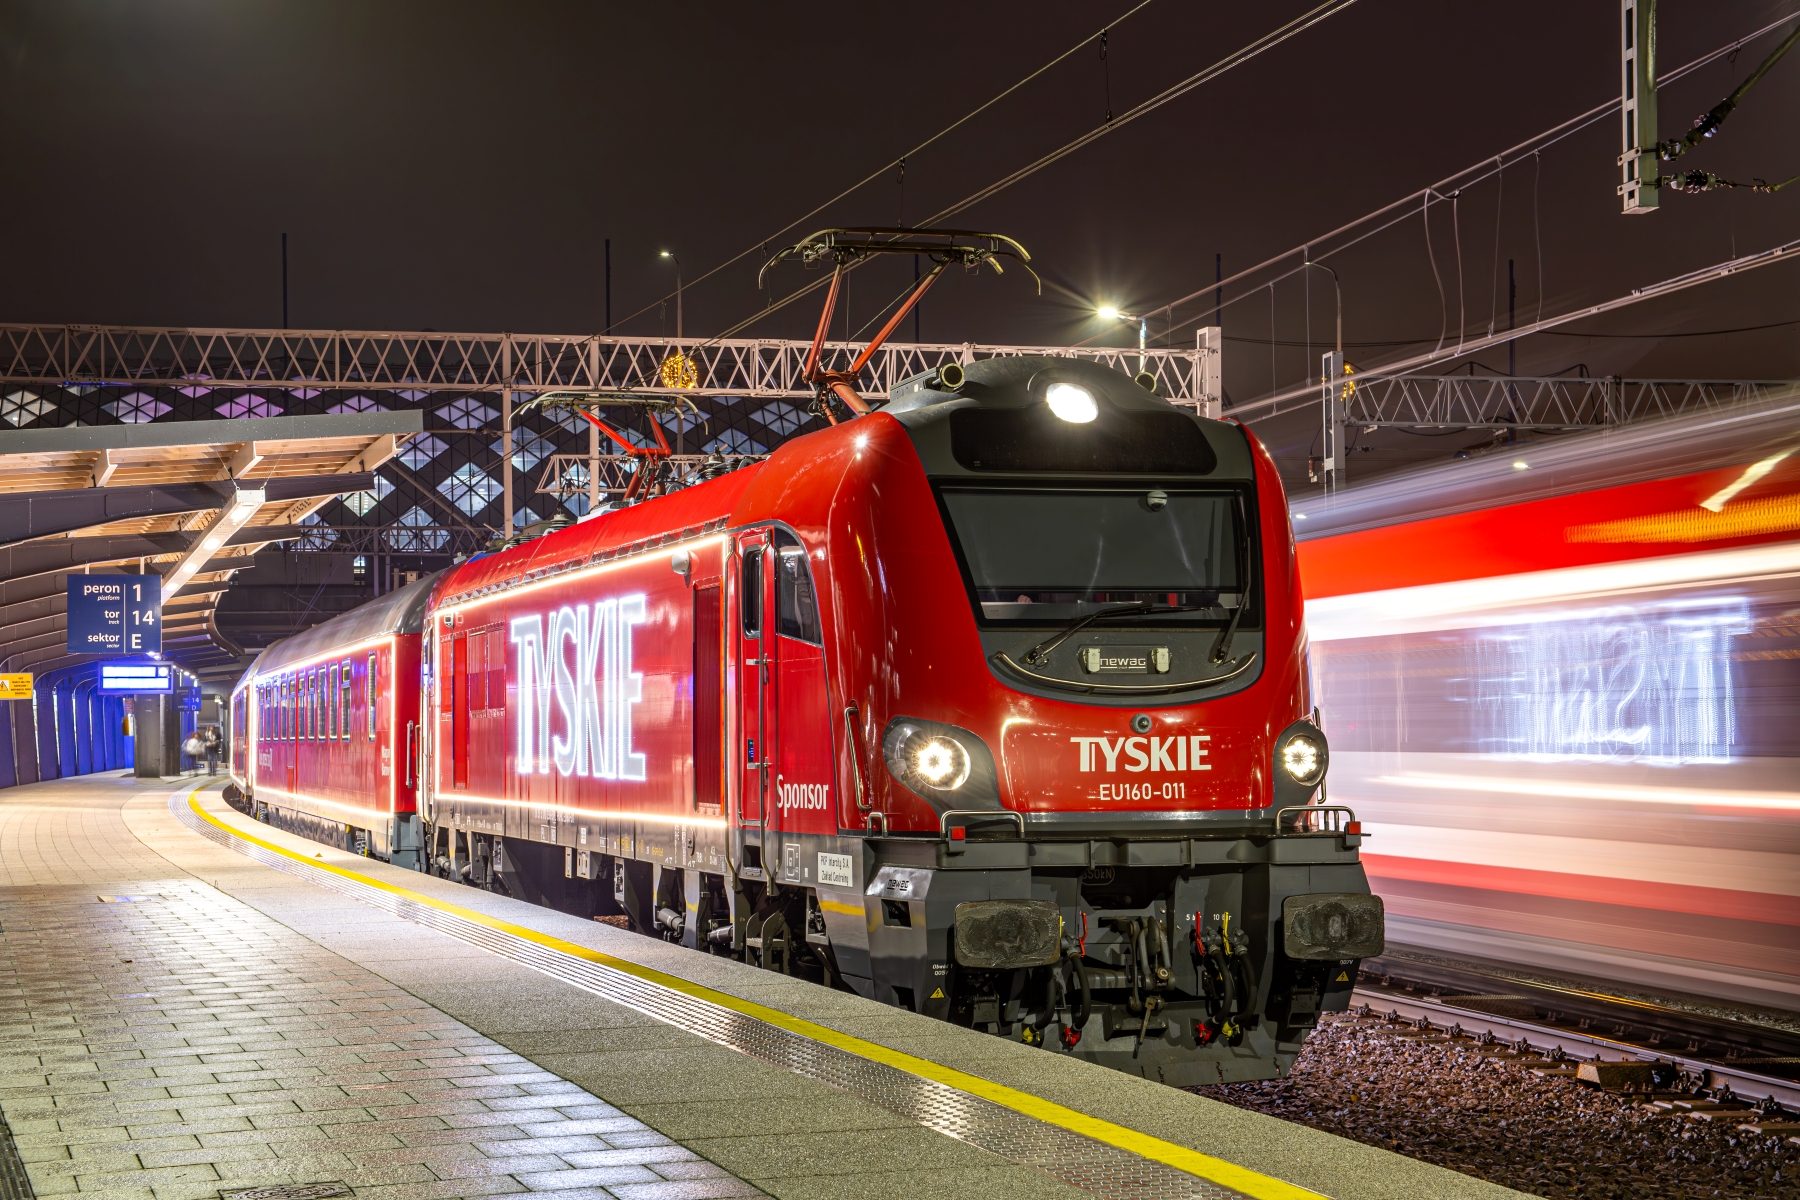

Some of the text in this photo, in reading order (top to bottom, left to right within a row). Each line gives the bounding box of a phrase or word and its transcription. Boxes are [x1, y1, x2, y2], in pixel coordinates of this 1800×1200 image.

[83, 583, 141, 602] peron 1
[104, 610, 155, 626] tor 14
[87, 633, 142, 649] sektor E
[510, 594, 646, 781] TYSKIE
[1070, 735, 1212, 772] TYSKIE
[776, 773, 829, 818] Sponsor
[1099, 782, 1186, 801] EU160-011
[820, 855, 828, 866] PKP
